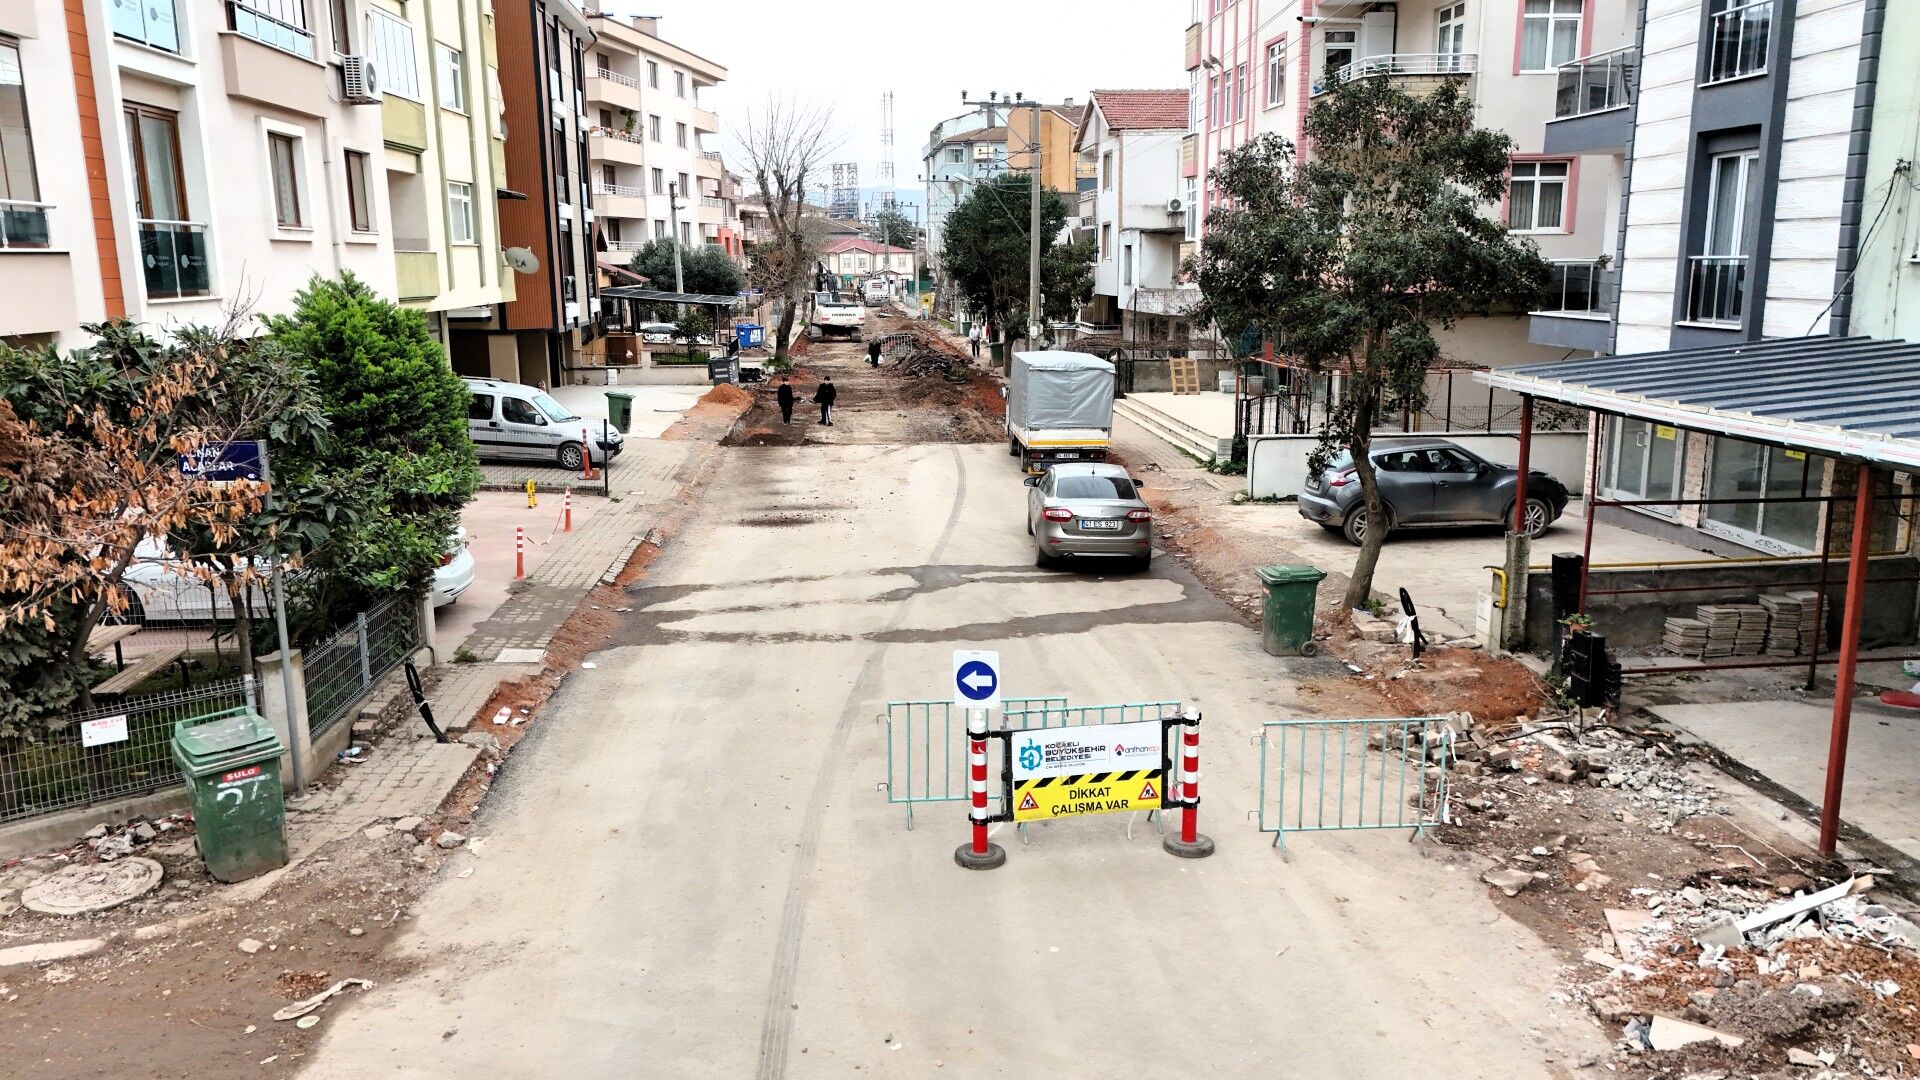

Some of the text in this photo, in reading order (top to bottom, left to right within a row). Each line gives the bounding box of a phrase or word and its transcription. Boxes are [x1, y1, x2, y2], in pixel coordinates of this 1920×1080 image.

[226, 768, 256, 781] SULO
[1069, 787, 1112, 800] DİKKAT
[1051, 799, 1129, 815] ÇALIŞMA VAR
